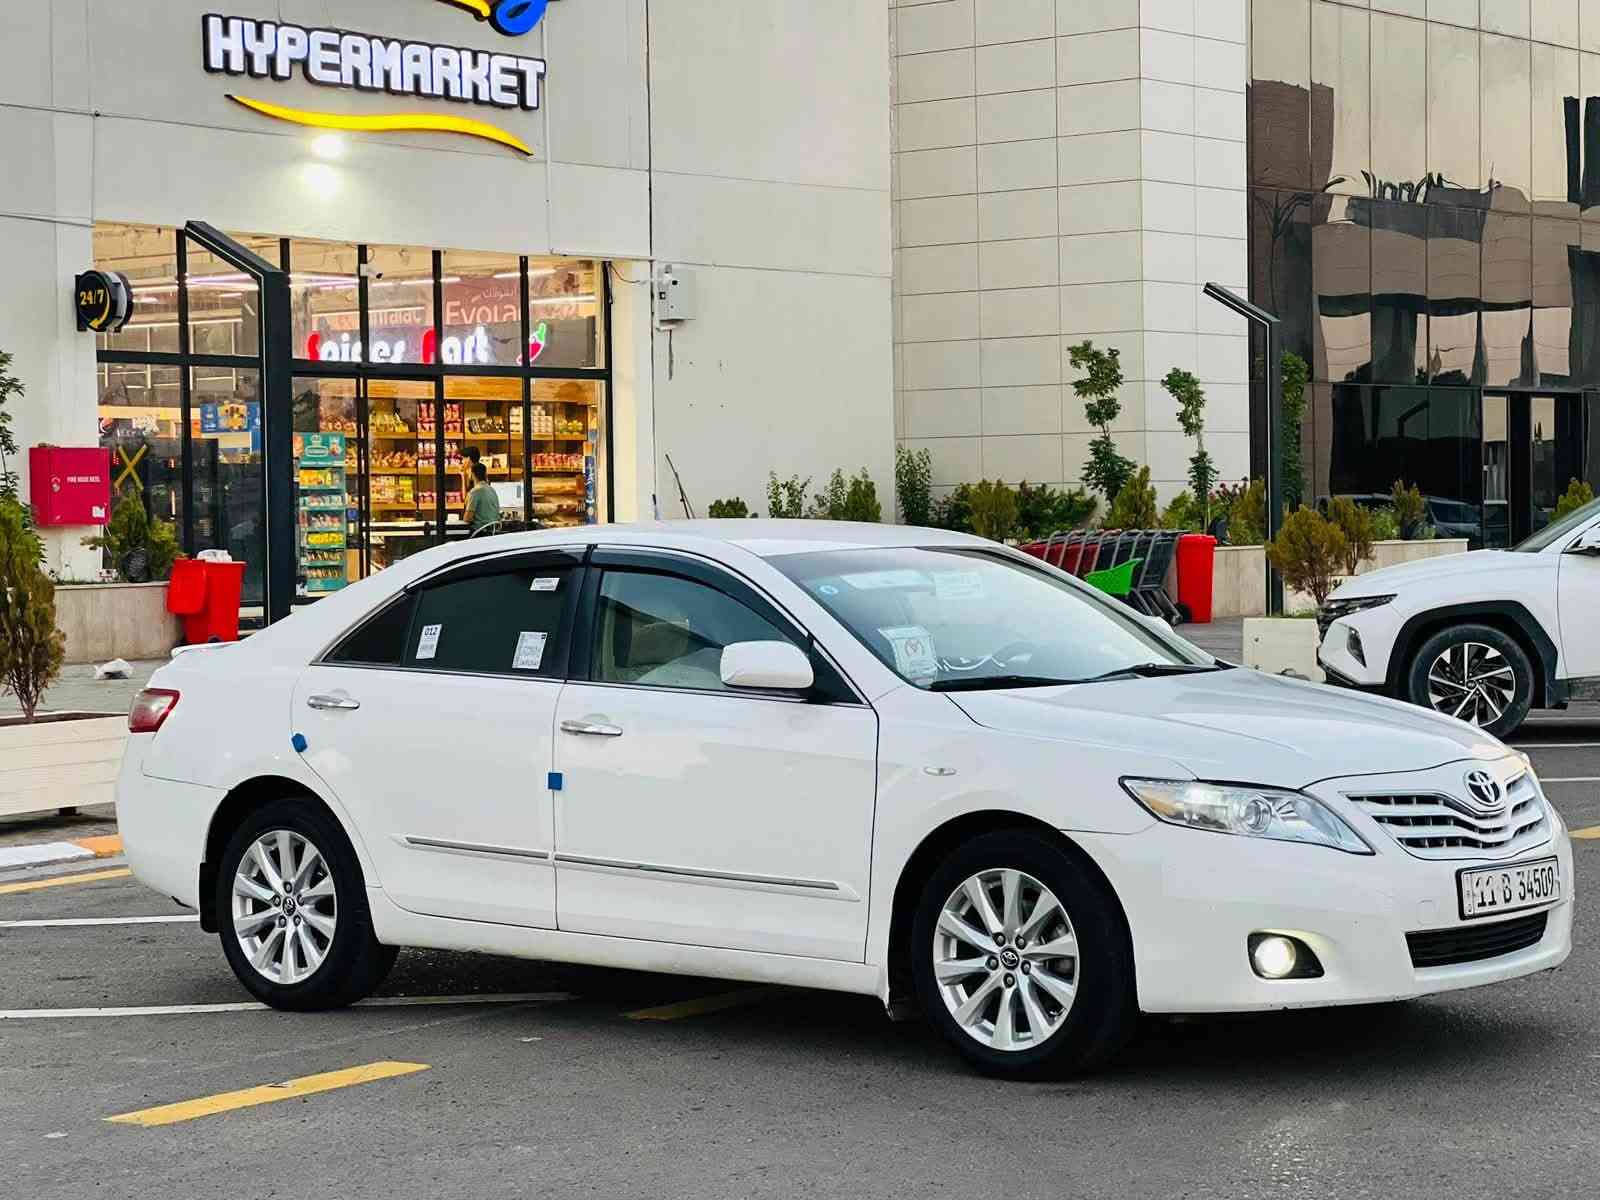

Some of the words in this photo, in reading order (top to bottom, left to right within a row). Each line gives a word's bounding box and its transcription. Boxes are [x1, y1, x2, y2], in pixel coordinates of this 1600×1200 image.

[204, 14, 546, 109] HYPERMARKET
[80, 289, 104, 305] 24/7
[1475, 875, 1497, 907] 11
